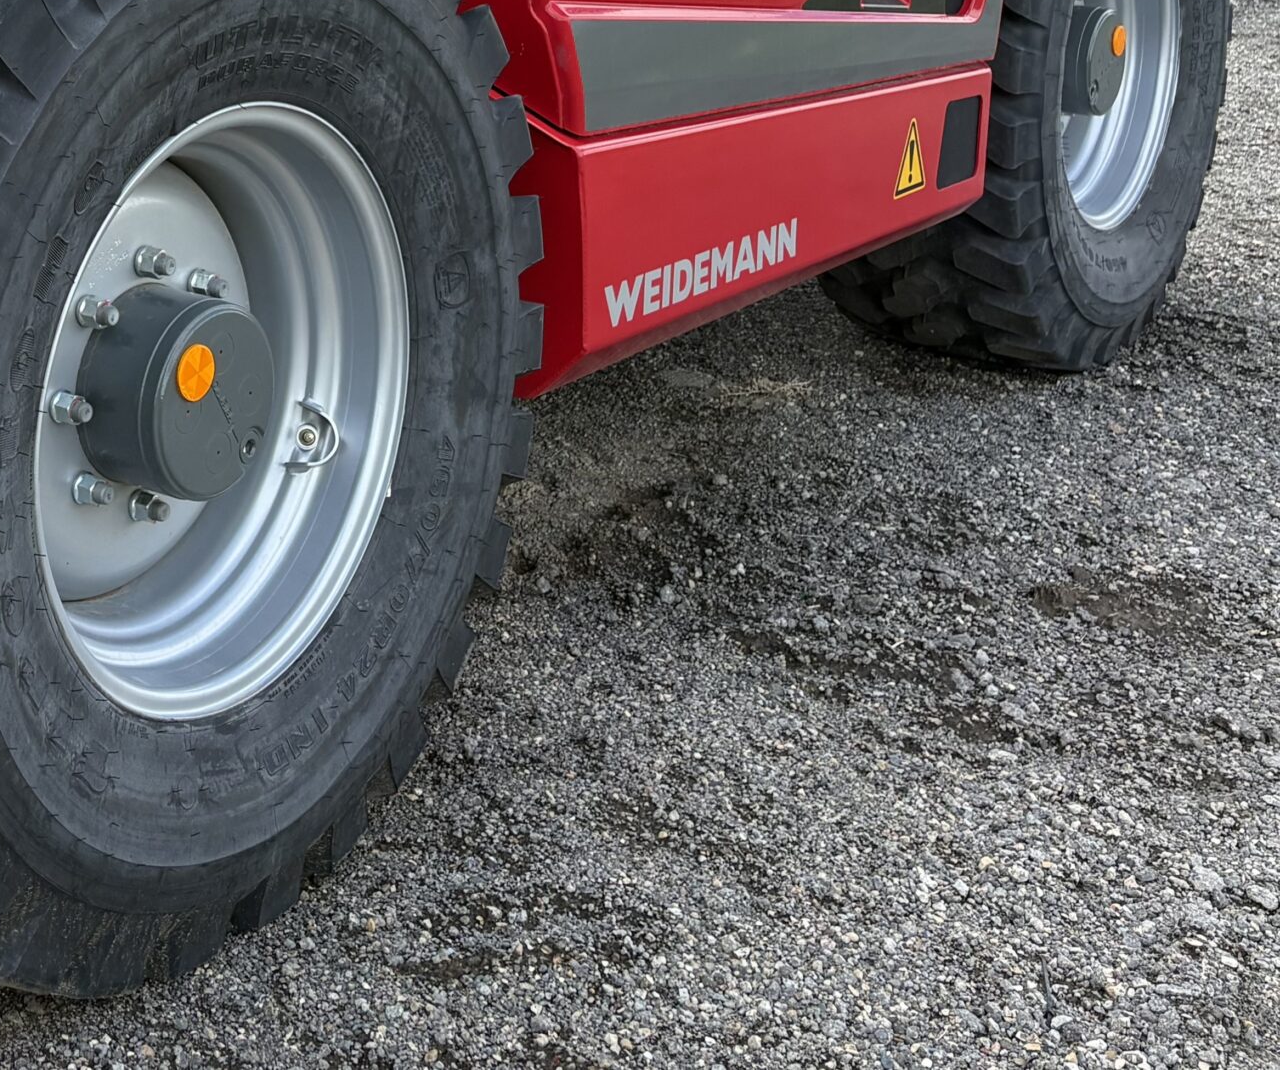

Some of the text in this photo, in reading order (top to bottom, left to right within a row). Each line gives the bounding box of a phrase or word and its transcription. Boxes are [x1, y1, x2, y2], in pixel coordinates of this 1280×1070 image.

[195, 14, 383, 70] UTILITY
[197, 51, 360, 95] DURAFORCE
[605, 218, 798, 328] WEIDEMANN
[260, 435, 456, 776] 460/70R24 IND
